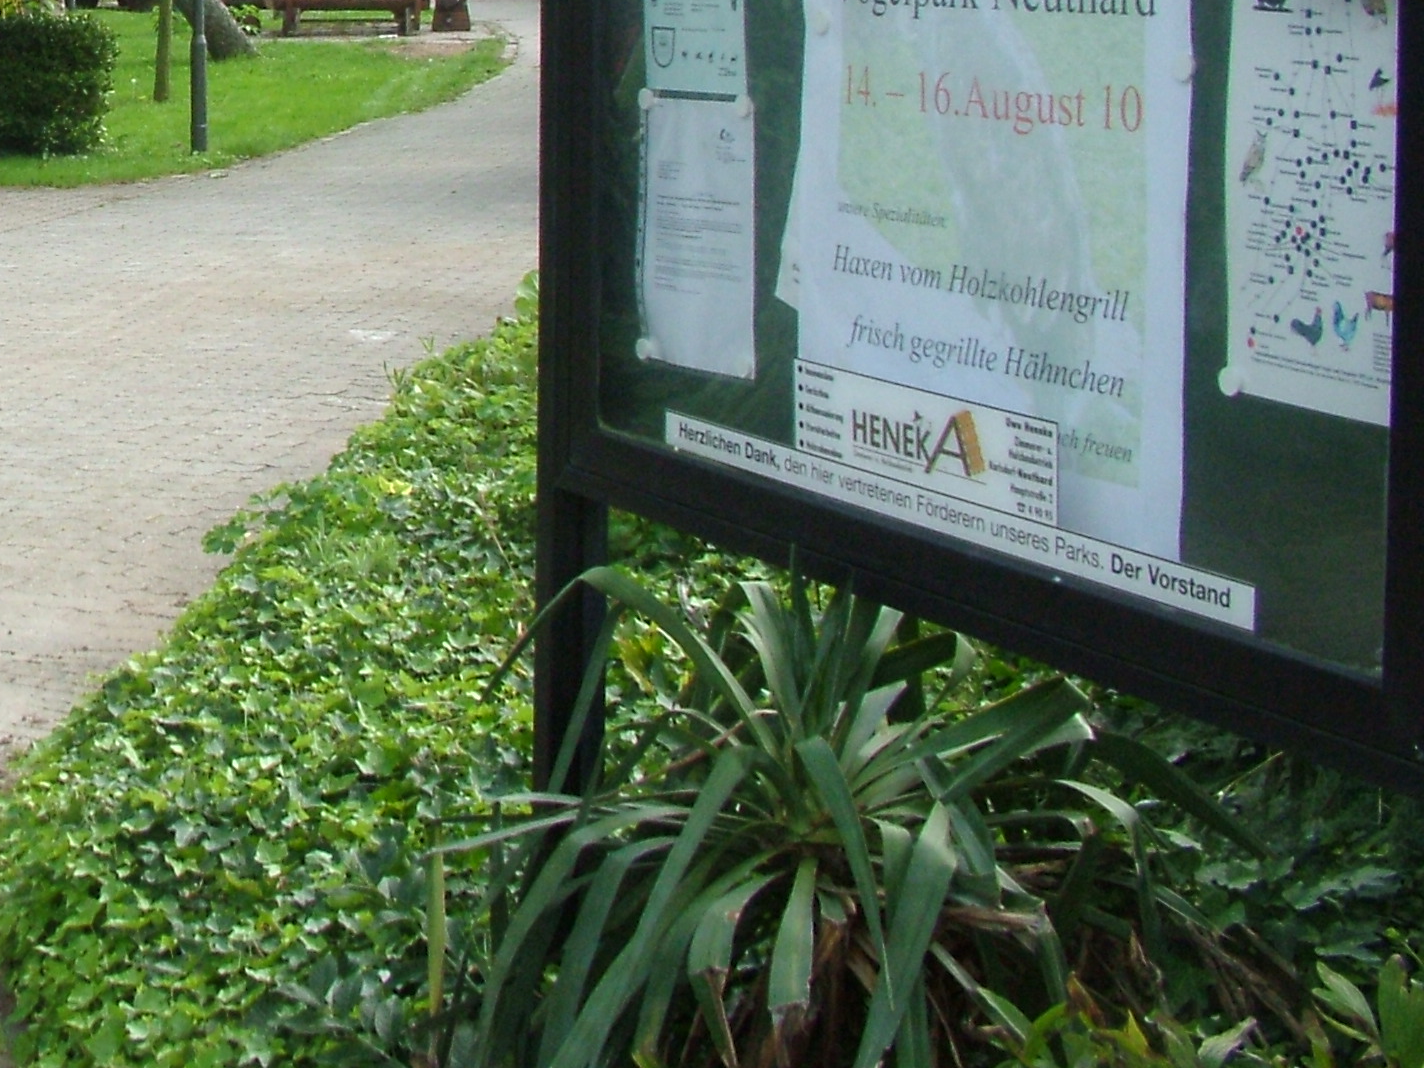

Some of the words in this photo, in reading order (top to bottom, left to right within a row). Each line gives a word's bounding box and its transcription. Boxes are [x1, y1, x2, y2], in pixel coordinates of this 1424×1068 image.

[846, 65, 876, 108] 14.
[1103, 85, 1143, 132] 10
[833, 244, 893, 282] Haxen
[900, 264, 942, 289] vom
[948, 264, 1130, 324] Holzkohlengrill
[846, 315, 904, 351] frisch
[910, 335, 998, 371] gegrillte
[1005, 346, 1124, 398] Hähnchen
[851, 409, 973, 477] HENEKA
[1080, 433, 1133, 462] freuen
[678, 423, 741, 455] Herzlichen
[745, 440, 780, 471] Dank,
[784, 455, 807, 475] den
[811, 462, 834, 485] hier
[838, 473, 913, 510] vertretenen
[917, 494, 986, 532] Förderern
[991, 522, 1050, 552] unseres
[1055, 537, 1104, 570] Parks.
[1111, 553, 1142, 581] Der
[1148, 568, 1232, 608] Vorstand
